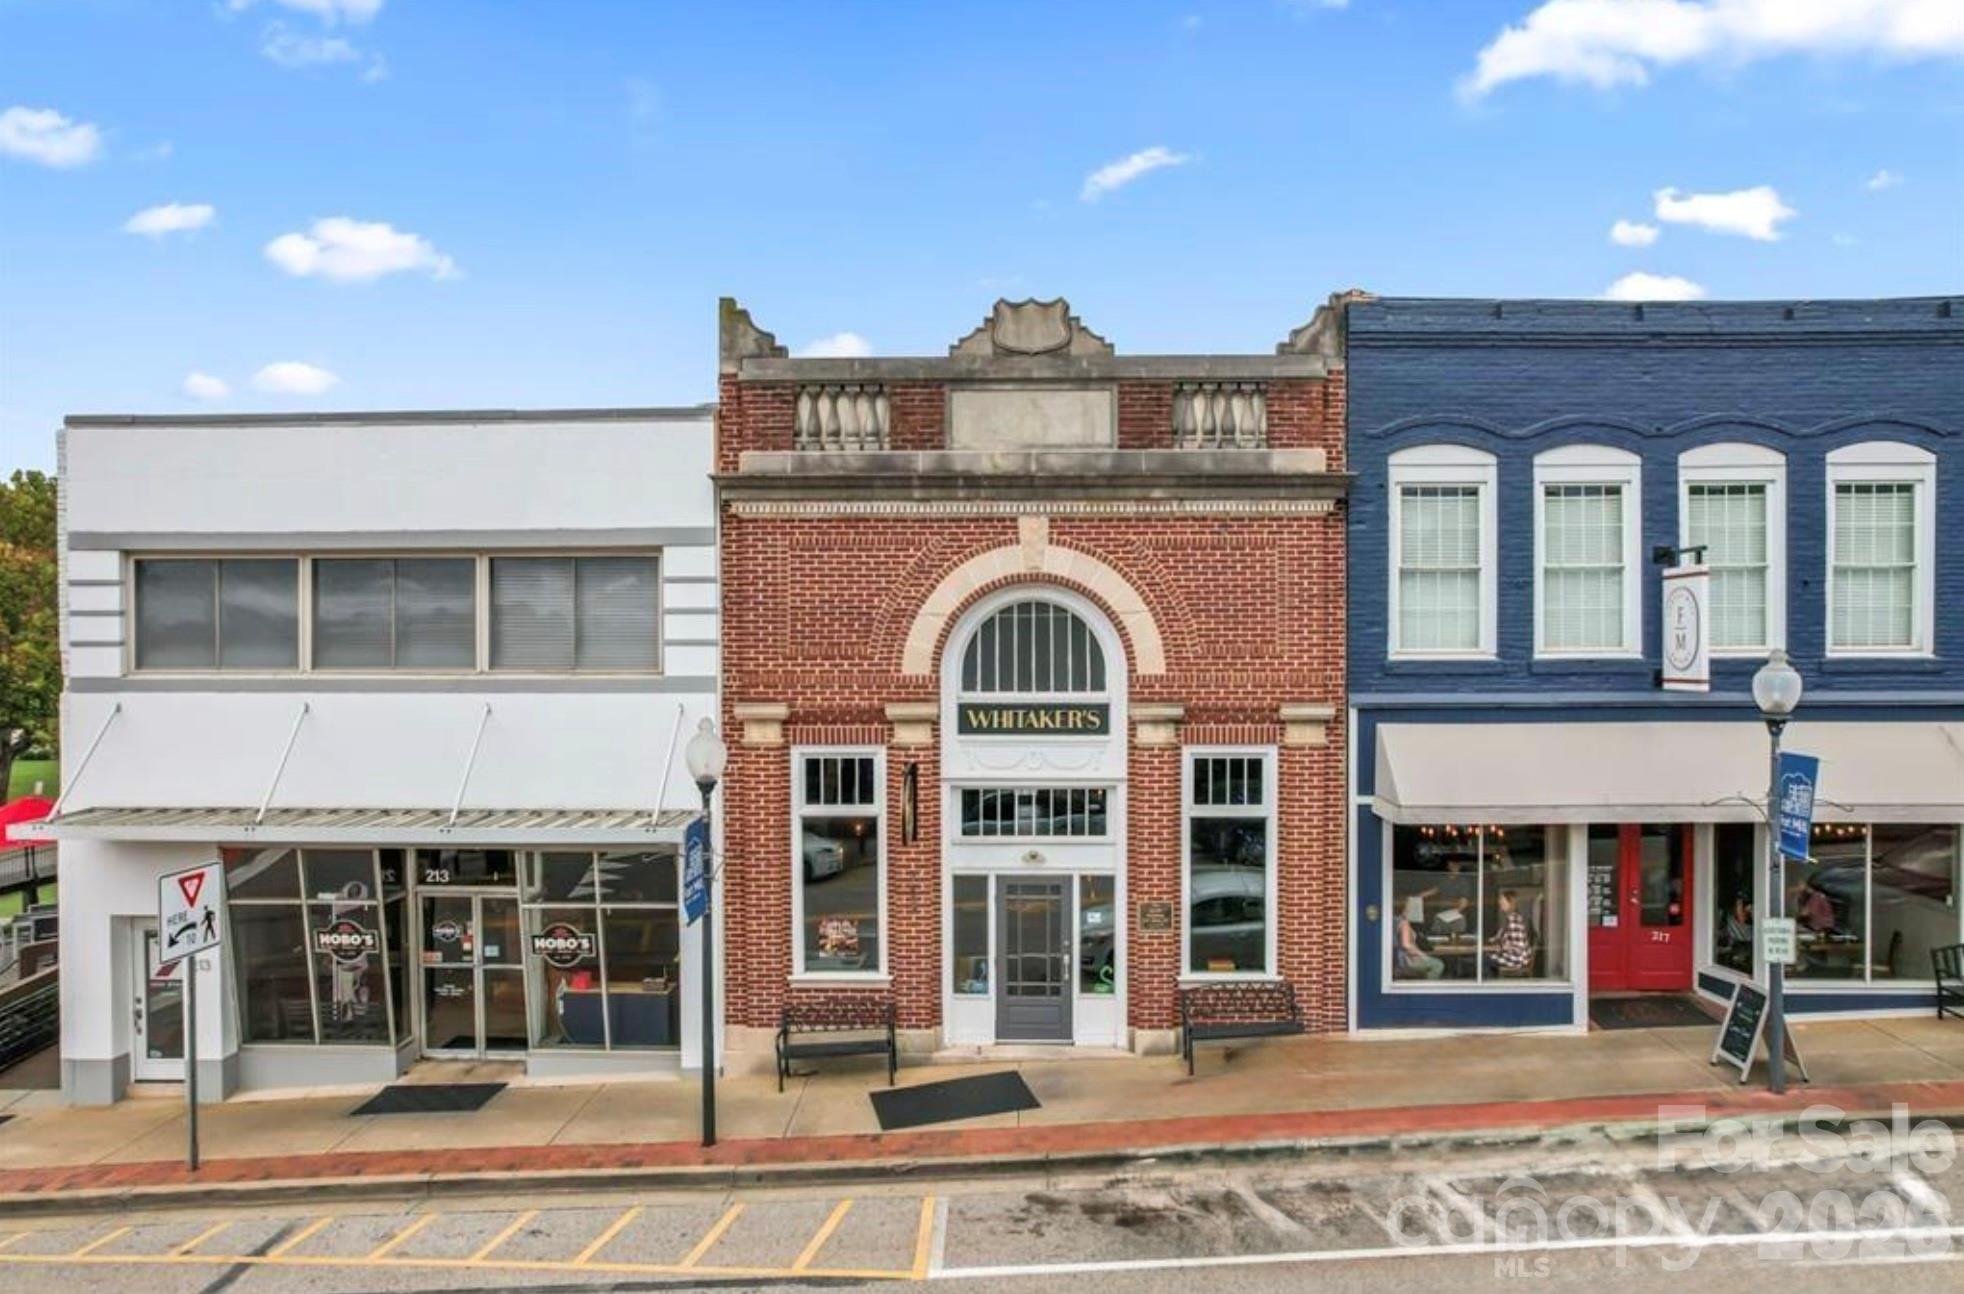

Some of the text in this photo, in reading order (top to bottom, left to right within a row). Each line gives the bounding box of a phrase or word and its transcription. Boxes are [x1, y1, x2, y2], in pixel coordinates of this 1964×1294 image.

[1675, 632, 1687, 650] M
[967, 709, 1101, 729] WHITAKER'S
[426, 869, 450, 883] 213
[318, 932, 375, 946] HOBO'S
[533, 937, 591, 951] HOBO'S
